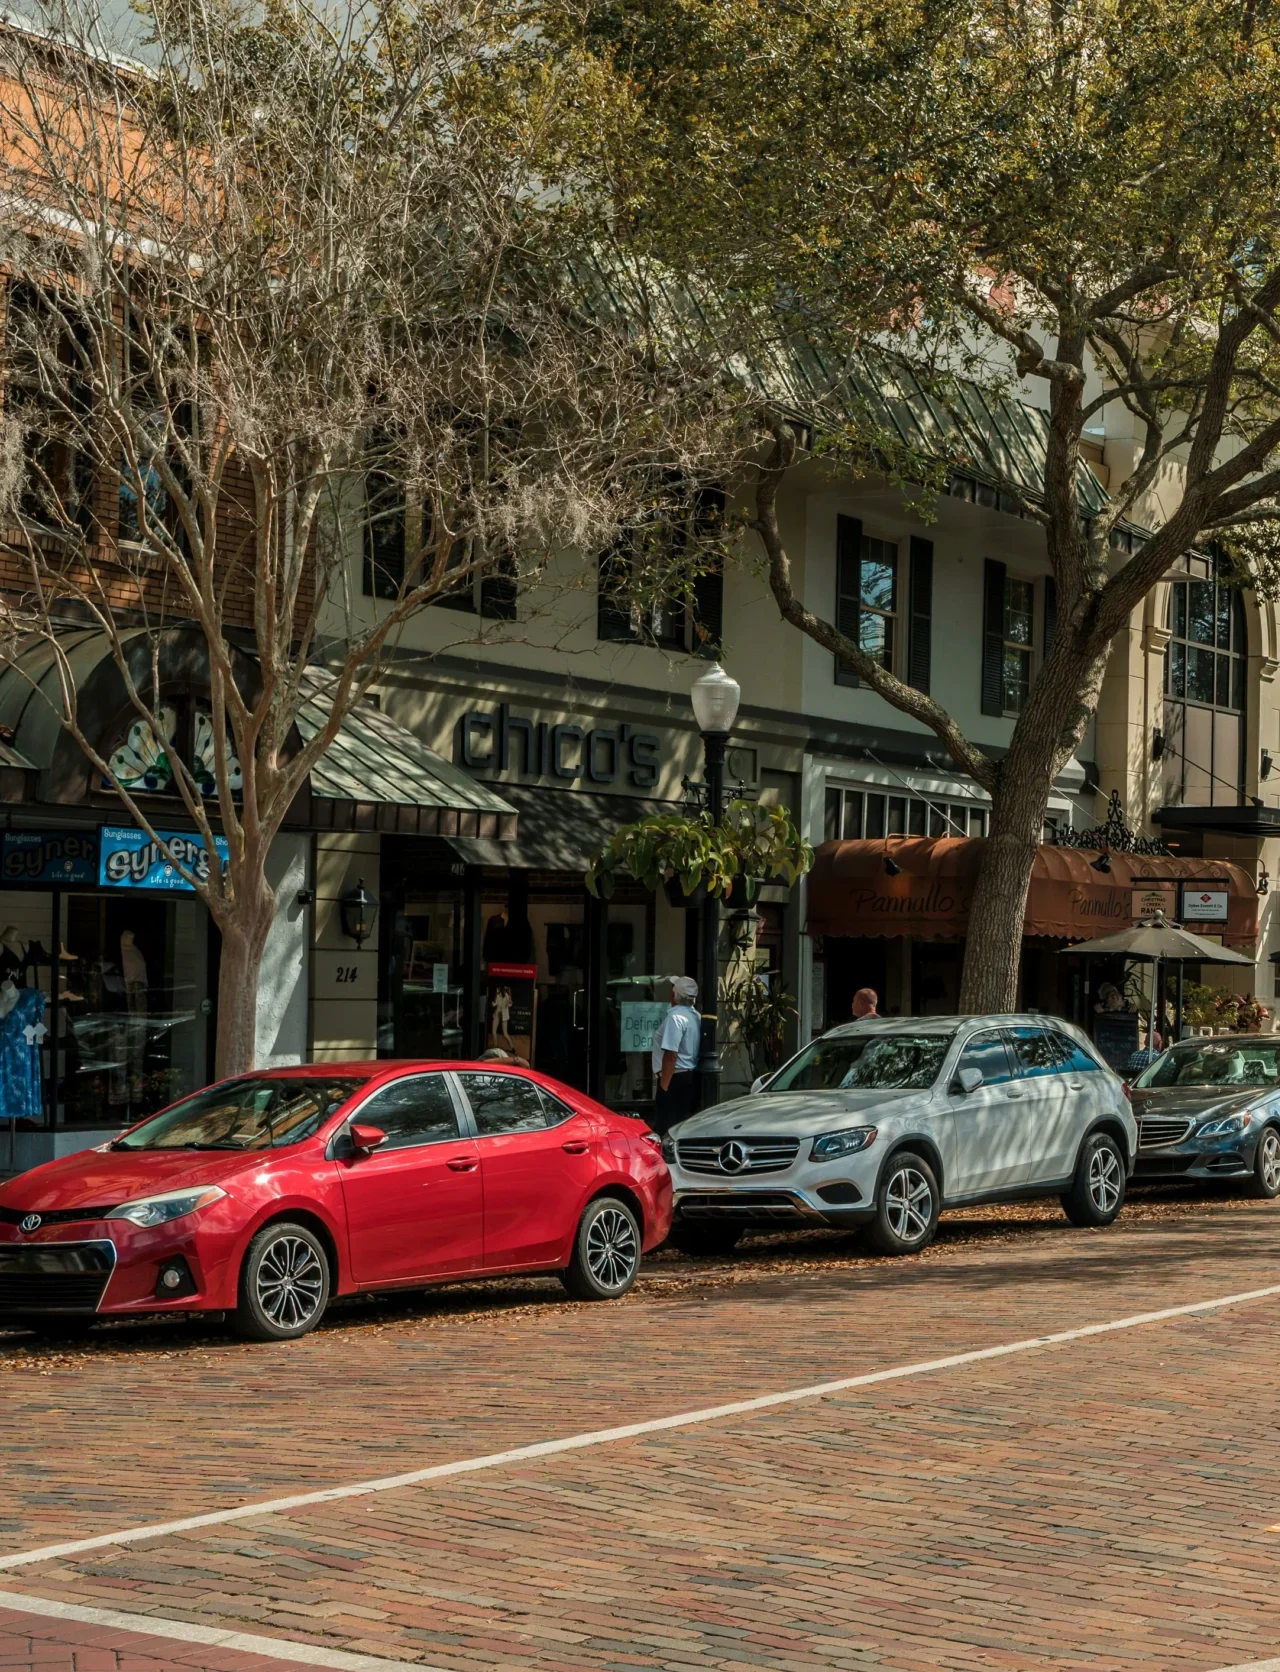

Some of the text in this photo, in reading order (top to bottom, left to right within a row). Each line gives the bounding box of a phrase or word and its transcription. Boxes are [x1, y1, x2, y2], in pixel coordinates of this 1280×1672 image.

[460, 703, 661, 788] chico's
[4, 832, 42, 845] Sunglasses
[103, 828, 142, 841] Sunglasses
[215, 837, 229, 846] Sho
[107, 836, 230, 884] Synerg
[849, 883, 970, 916] Pannullo's
[1068, 887, 1131, 921] Pannullo's
[335, 966, 358, 983] 214
[625, 1016, 662, 1031] Define
[633, 1034, 654, 1048] Den
